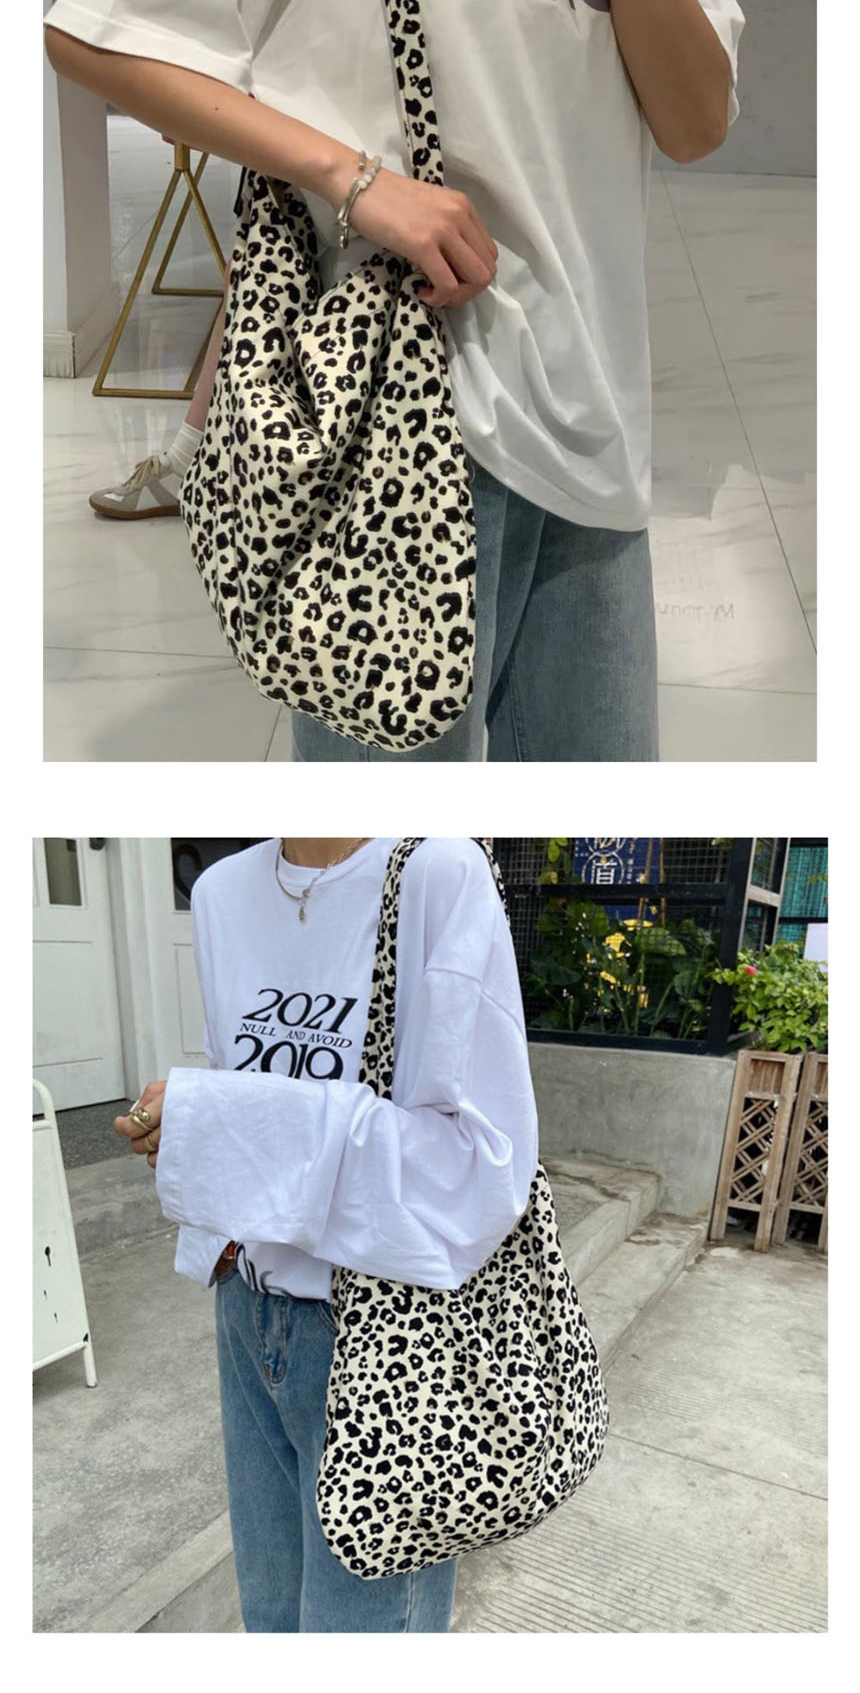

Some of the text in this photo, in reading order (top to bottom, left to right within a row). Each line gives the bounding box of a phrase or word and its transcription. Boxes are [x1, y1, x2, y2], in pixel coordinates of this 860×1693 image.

[241, 988, 358, 1034] 2021
[234, 1033, 344, 1080] 2019
[240, 1023, 352, 1049] NULL AND AVOID
